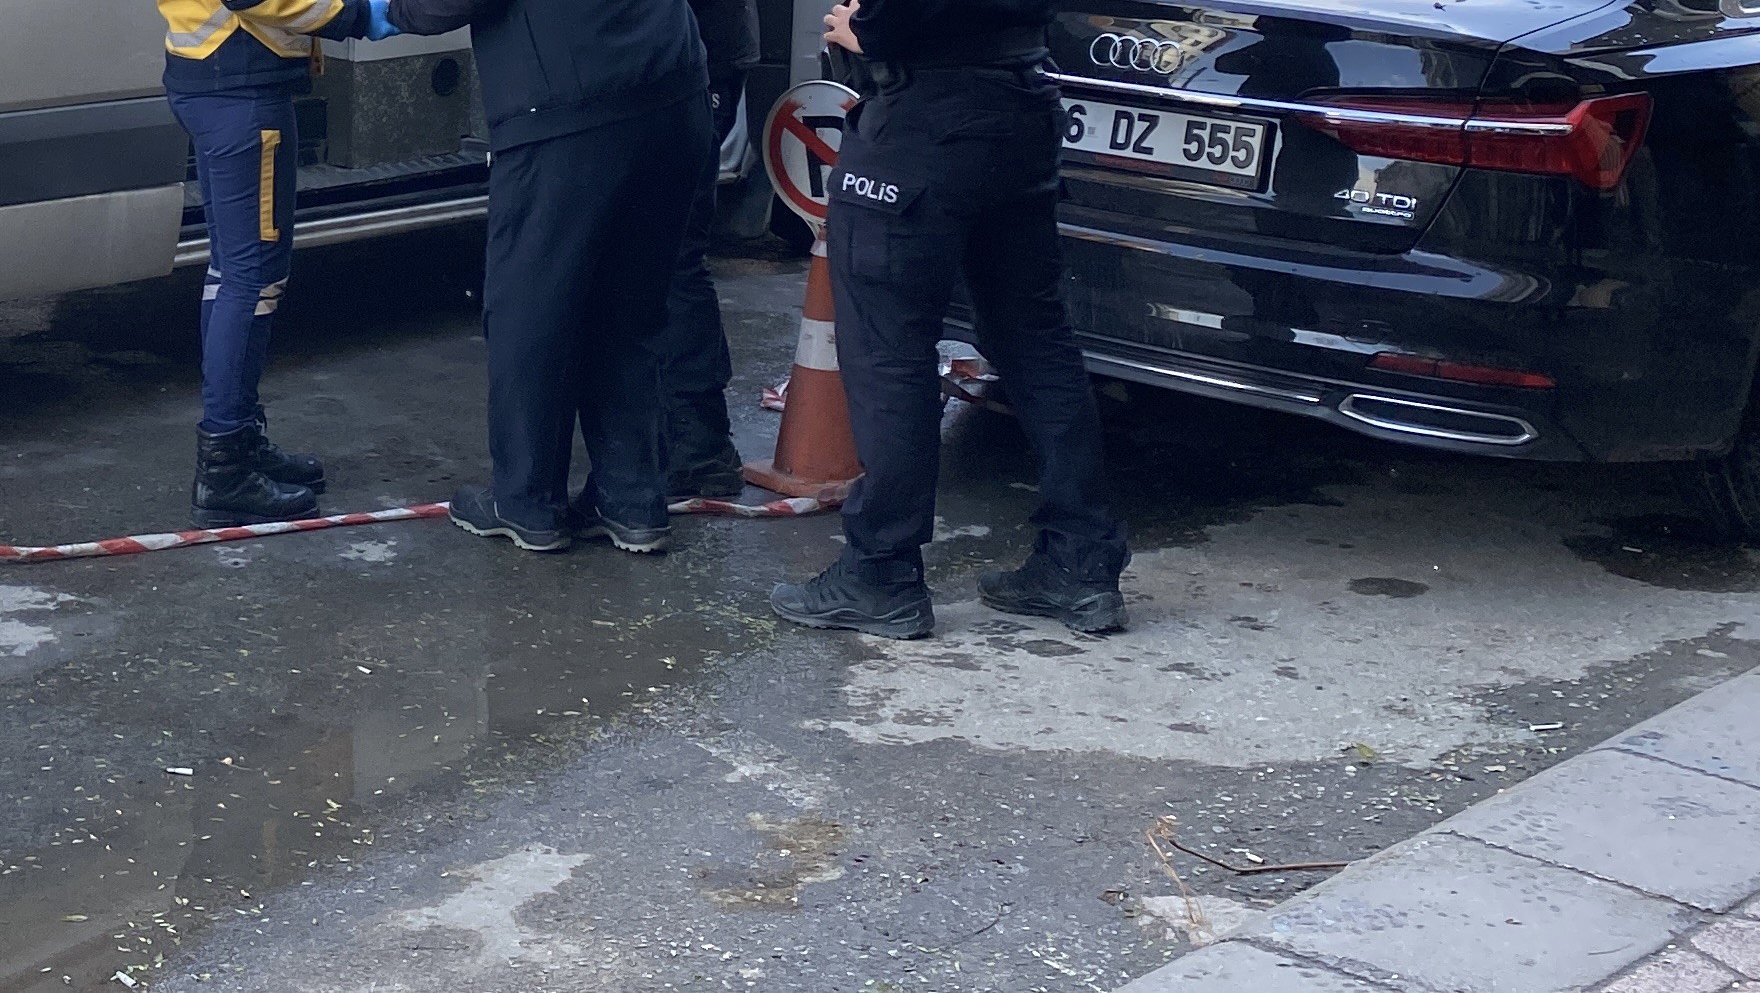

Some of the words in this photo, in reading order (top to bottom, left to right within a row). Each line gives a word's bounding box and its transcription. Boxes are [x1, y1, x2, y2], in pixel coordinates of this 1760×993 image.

[1063, 104, 1087, 144] 6
[1109, 109, 1160, 156] DZ
[1182, 119, 1256, 170] 555
[1333, 188, 1370, 203] 40
[1376, 192, 1417, 210] TDI
